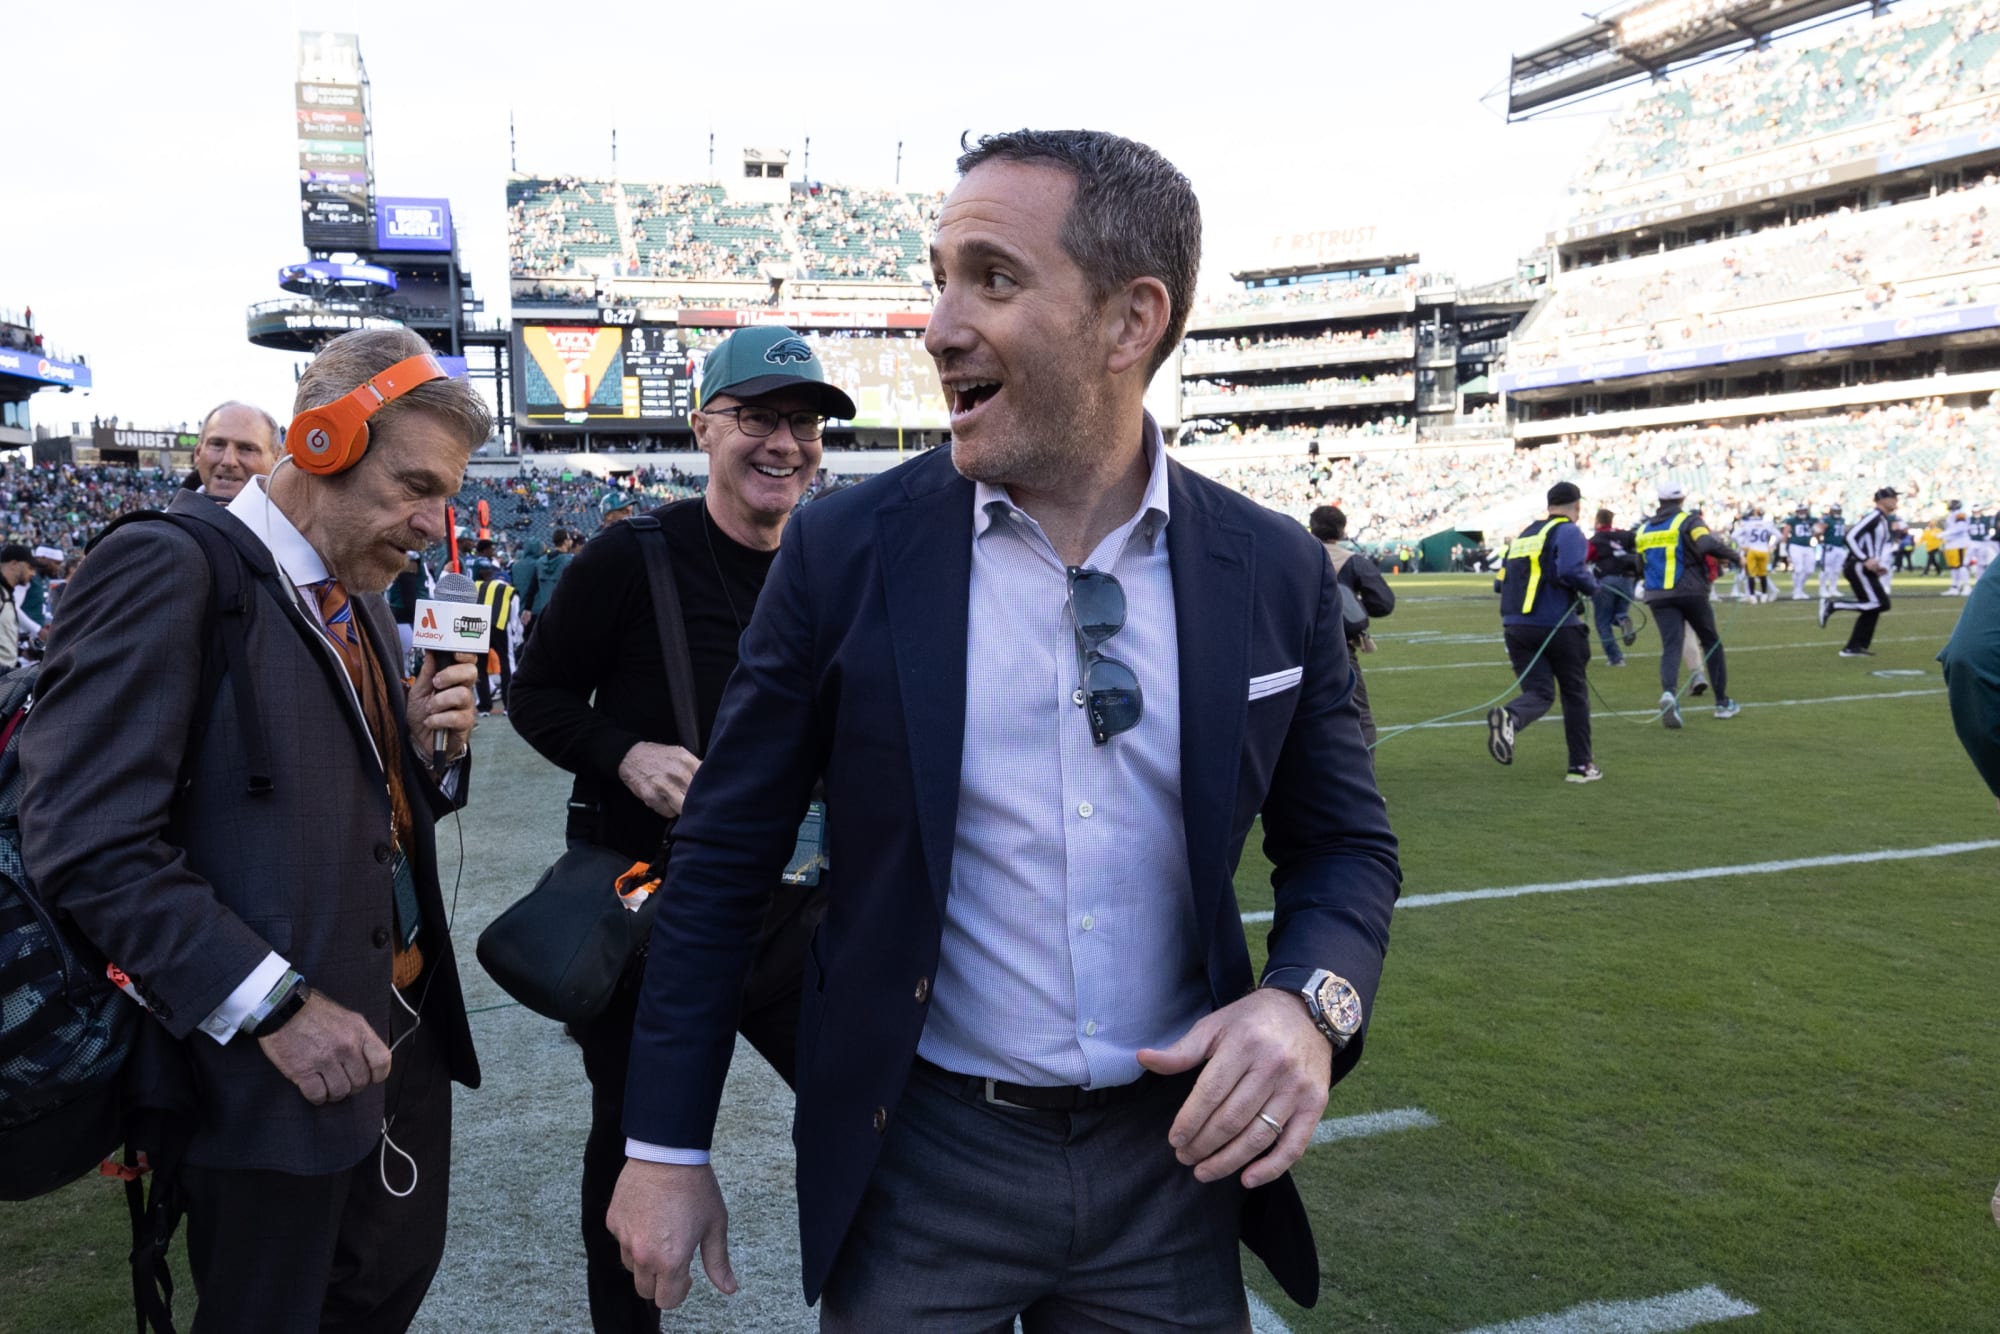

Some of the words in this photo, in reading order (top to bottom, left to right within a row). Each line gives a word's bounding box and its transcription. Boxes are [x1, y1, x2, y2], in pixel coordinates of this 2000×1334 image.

[389, 220, 439, 236] LIGHT
[1272, 224, 1377, 251] FRSTRUST
[285, 315, 311, 328] THIS
[312, 315, 348, 328] GAME
[350, 317, 362, 329] IS
[602, 308, 637, 324] 0:27
[546, 332, 600, 348] VIZZY
[631, 339, 646, 352] 13
[113, 431, 178, 449] UNIBET
[1750, 528, 1770, 544] 50
[415, 630, 444, 642] Audacy
